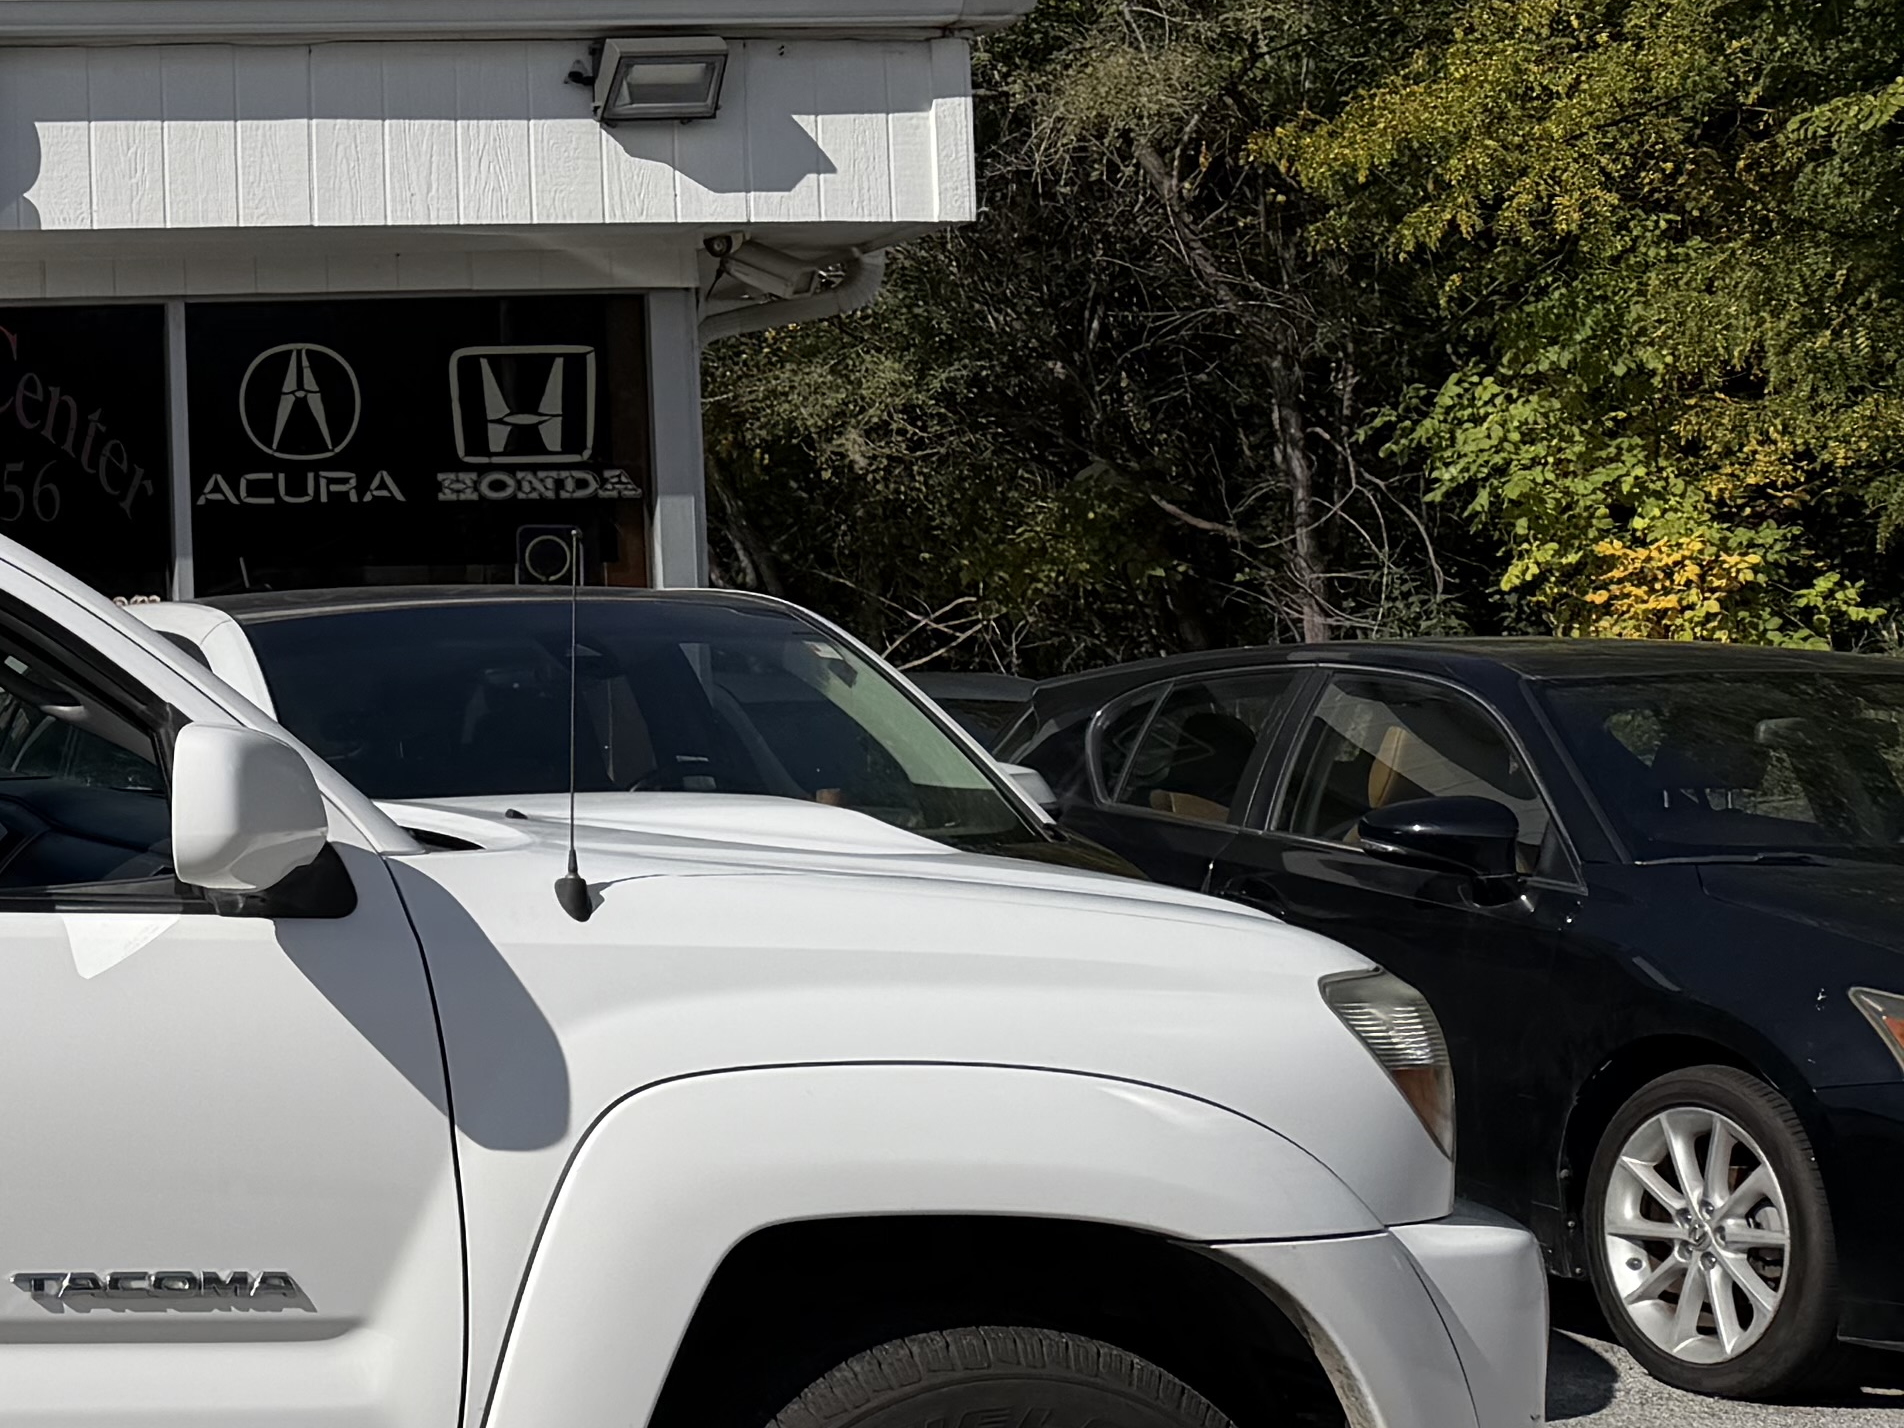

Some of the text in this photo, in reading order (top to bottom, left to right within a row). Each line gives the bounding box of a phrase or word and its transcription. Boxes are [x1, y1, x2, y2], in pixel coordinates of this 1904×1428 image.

[196, 469, 407, 505] ACURA
[436, 468, 643, 501] HONDA
[7, 1269, 304, 1304] TACOMA
